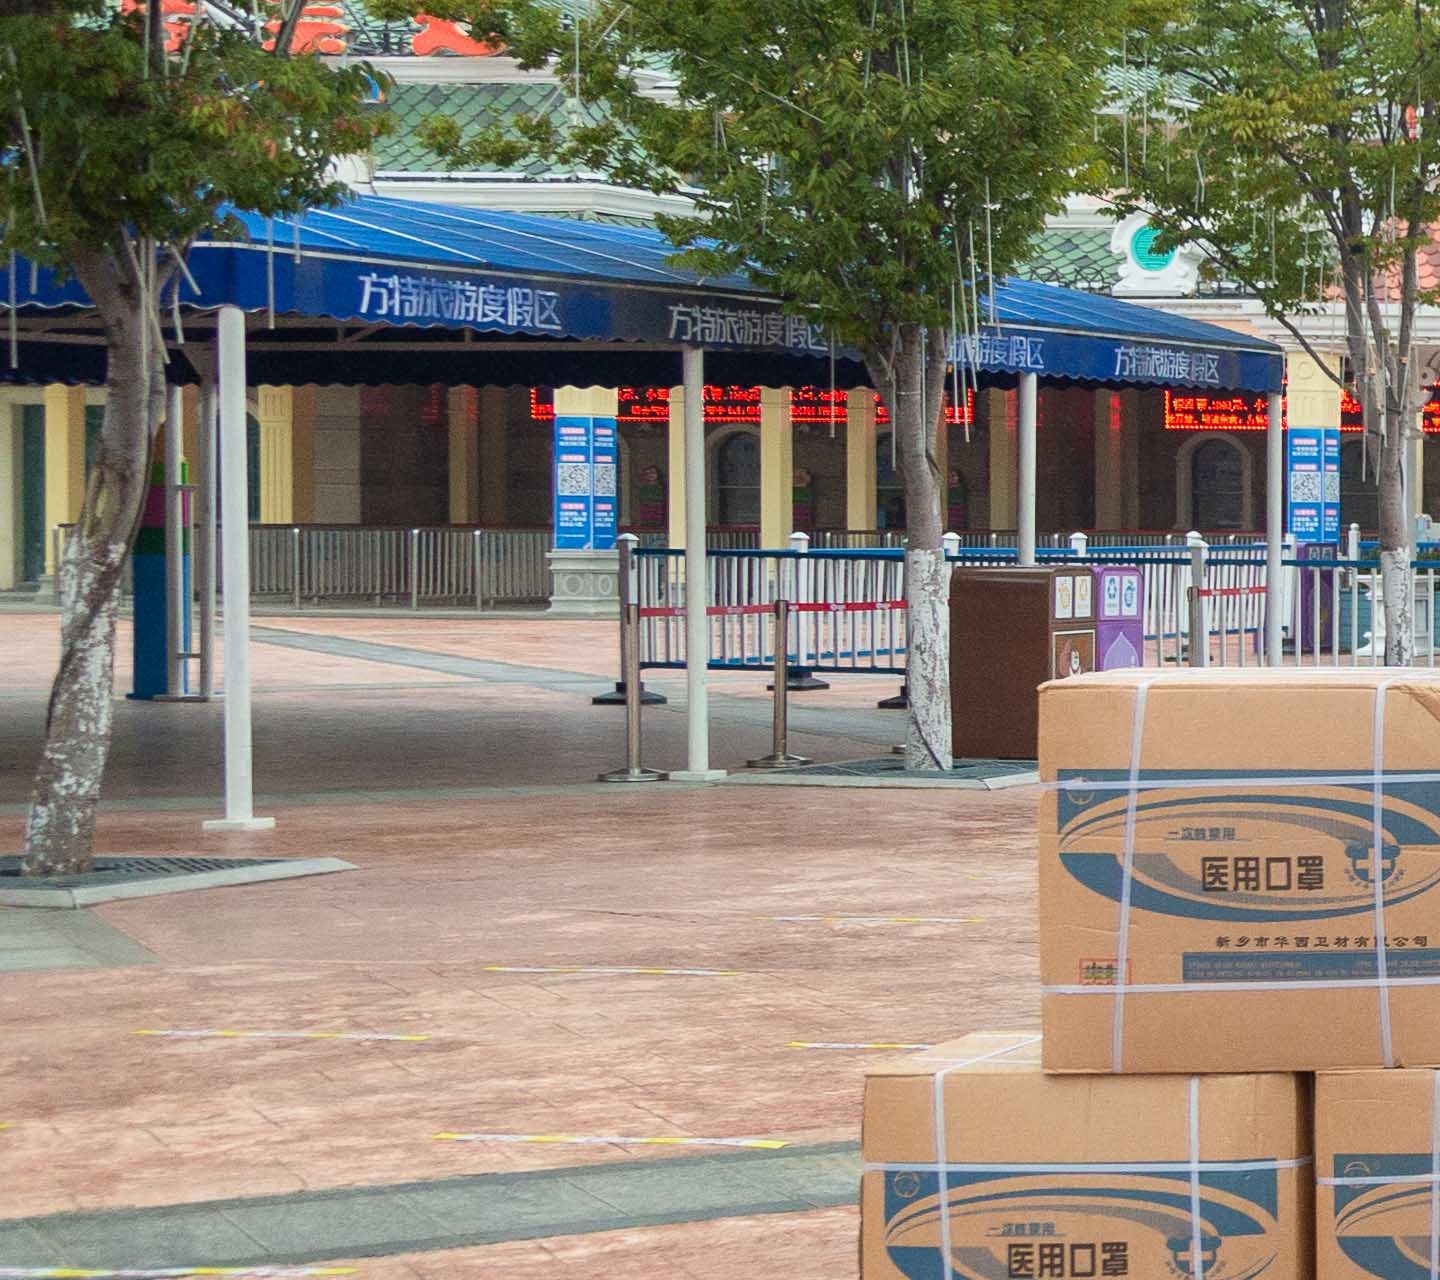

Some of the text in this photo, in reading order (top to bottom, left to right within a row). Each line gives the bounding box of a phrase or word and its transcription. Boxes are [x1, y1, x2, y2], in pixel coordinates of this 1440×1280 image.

[358, 272, 563, 332] 方特旅游度假区
[1114, 344, 1220, 384] 方特旅游度假区
[1201, 855, 1324, 892] 医用口罩
[1007, 1242, 1129, 1278] 医用口罩
